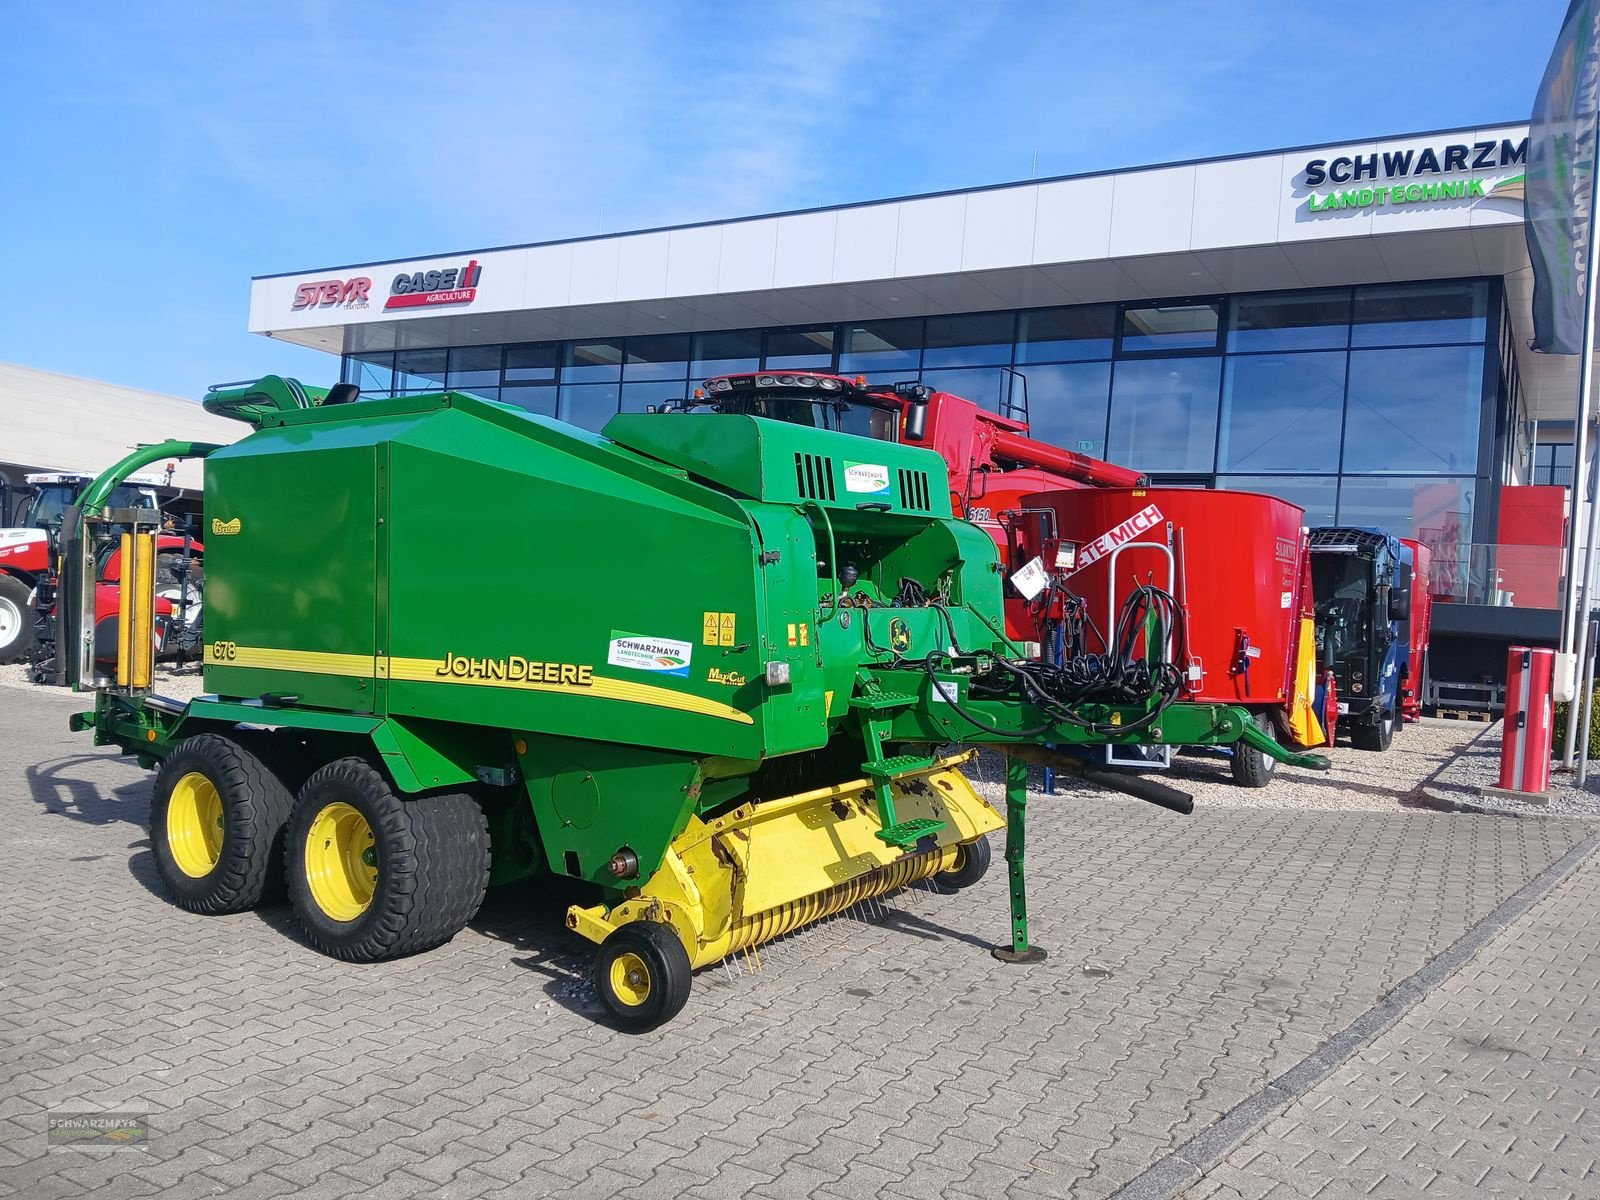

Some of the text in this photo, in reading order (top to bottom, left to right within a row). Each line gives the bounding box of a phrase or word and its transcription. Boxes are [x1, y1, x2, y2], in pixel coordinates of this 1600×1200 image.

[1305, 137, 1529, 187] SCHWARZM
[1308, 178, 1485, 212] LANDTECHNIK
[293, 277, 372, 307] STEYR
[392, 268, 459, 294] CASE
[426, 290, 471, 302] AGRICULTURE
[969, 507, 991, 521] 6150
[1108, 506, 1162, 546] MICH
[213, 640, 236, 660] 678
[617, 640, 680, 657] SCHWARZMAYR
[617, 649, 654, 660] LANDTECHNIK
[437, 652, 594, 687] JOHN DEERE
[709, 668, 746, 684] MaxiCut
